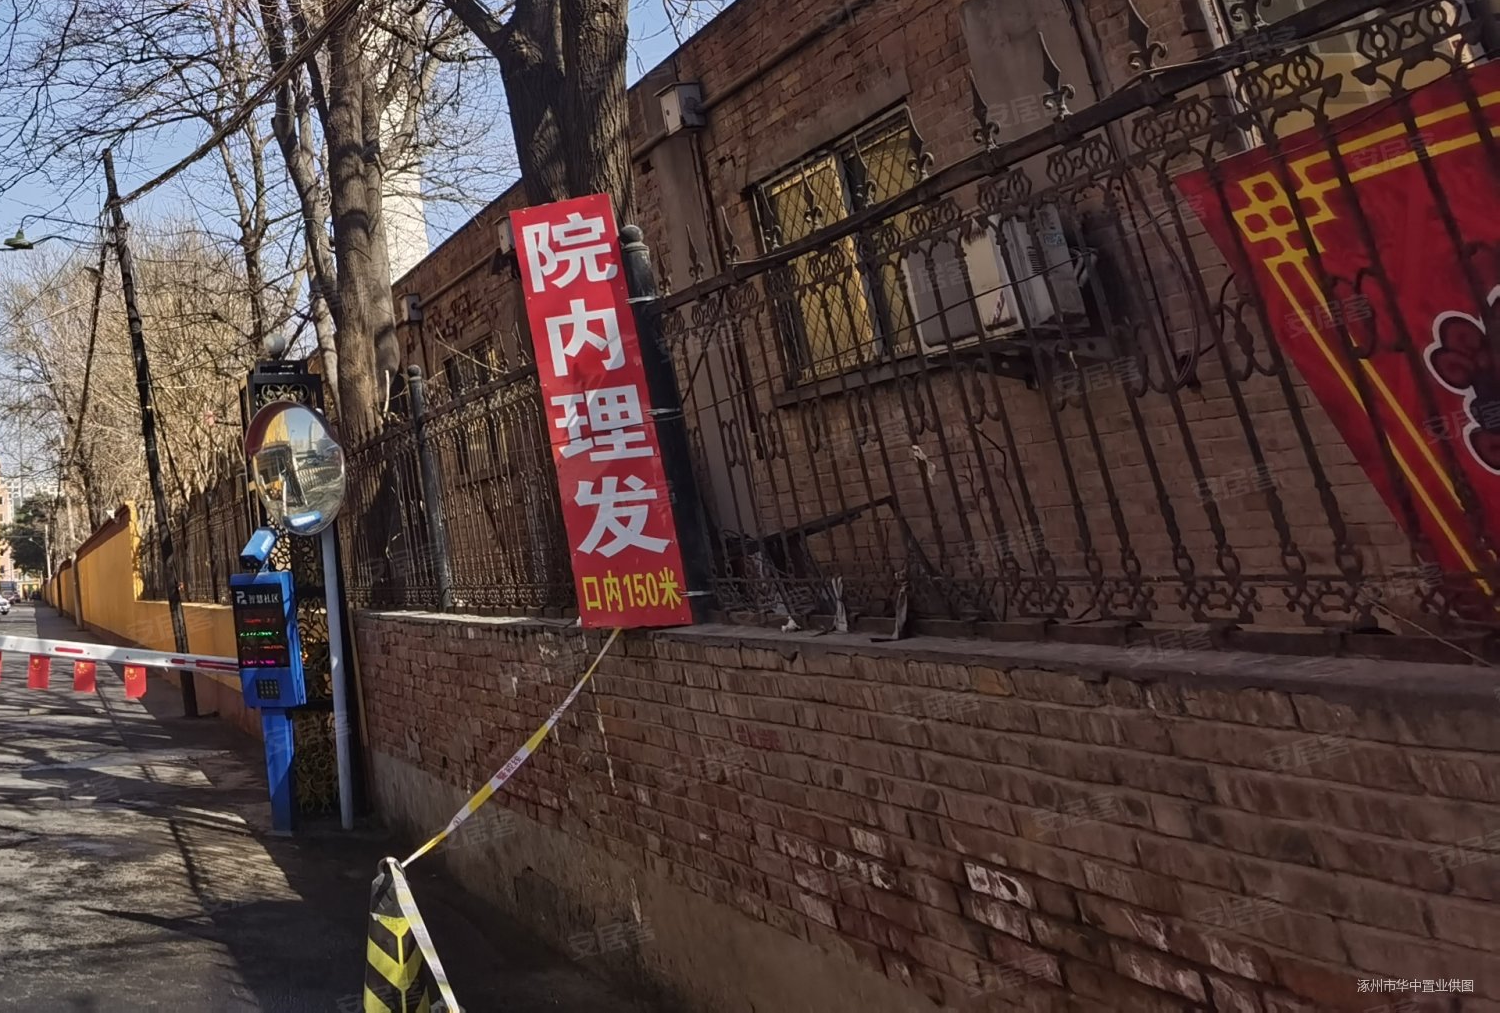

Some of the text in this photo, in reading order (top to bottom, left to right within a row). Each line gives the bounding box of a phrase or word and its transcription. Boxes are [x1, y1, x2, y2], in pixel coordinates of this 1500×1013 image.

[521, 211, 671, 559] 院内理发
[582, 566, 682, 613] 口内150米
